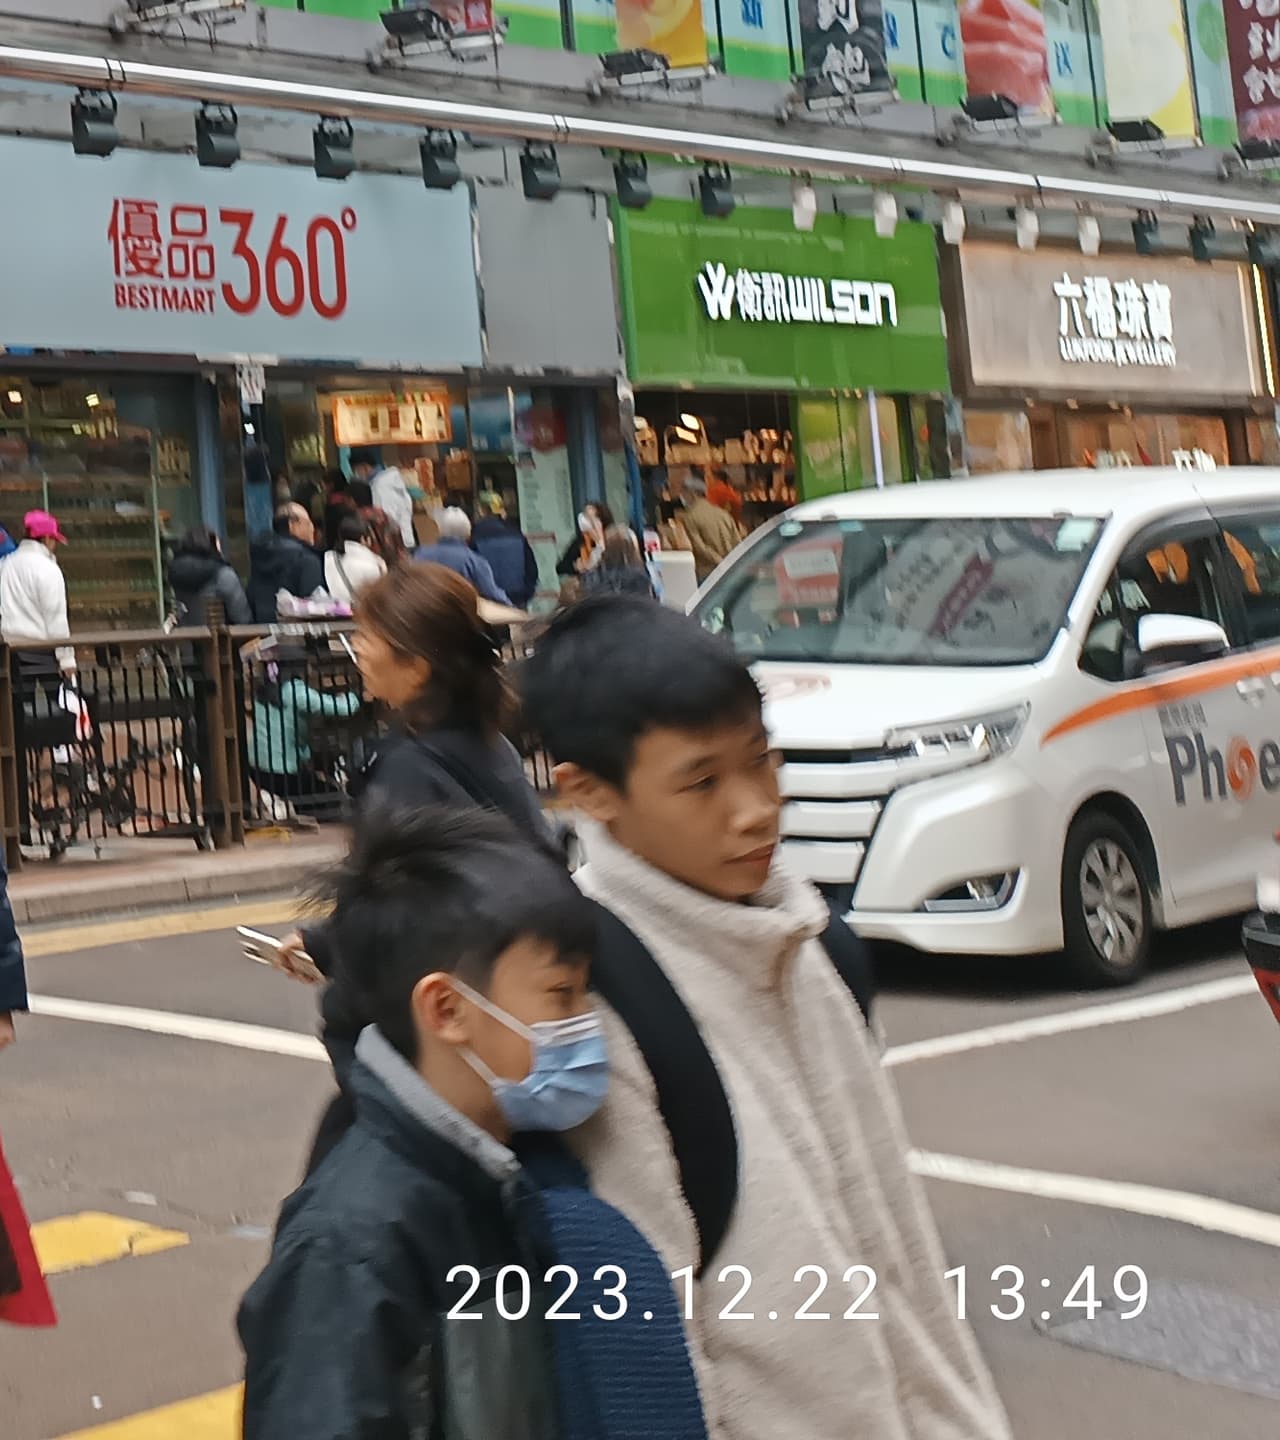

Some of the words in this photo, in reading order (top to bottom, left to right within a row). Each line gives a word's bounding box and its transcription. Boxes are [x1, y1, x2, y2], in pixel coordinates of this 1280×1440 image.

[107, 196, 216, 281] 優品
[113, 282, 217, 315] BESTMART
[789, 273, 898, 328] WILSON
[1052, 271, 1174, 342] 六福珠寶
